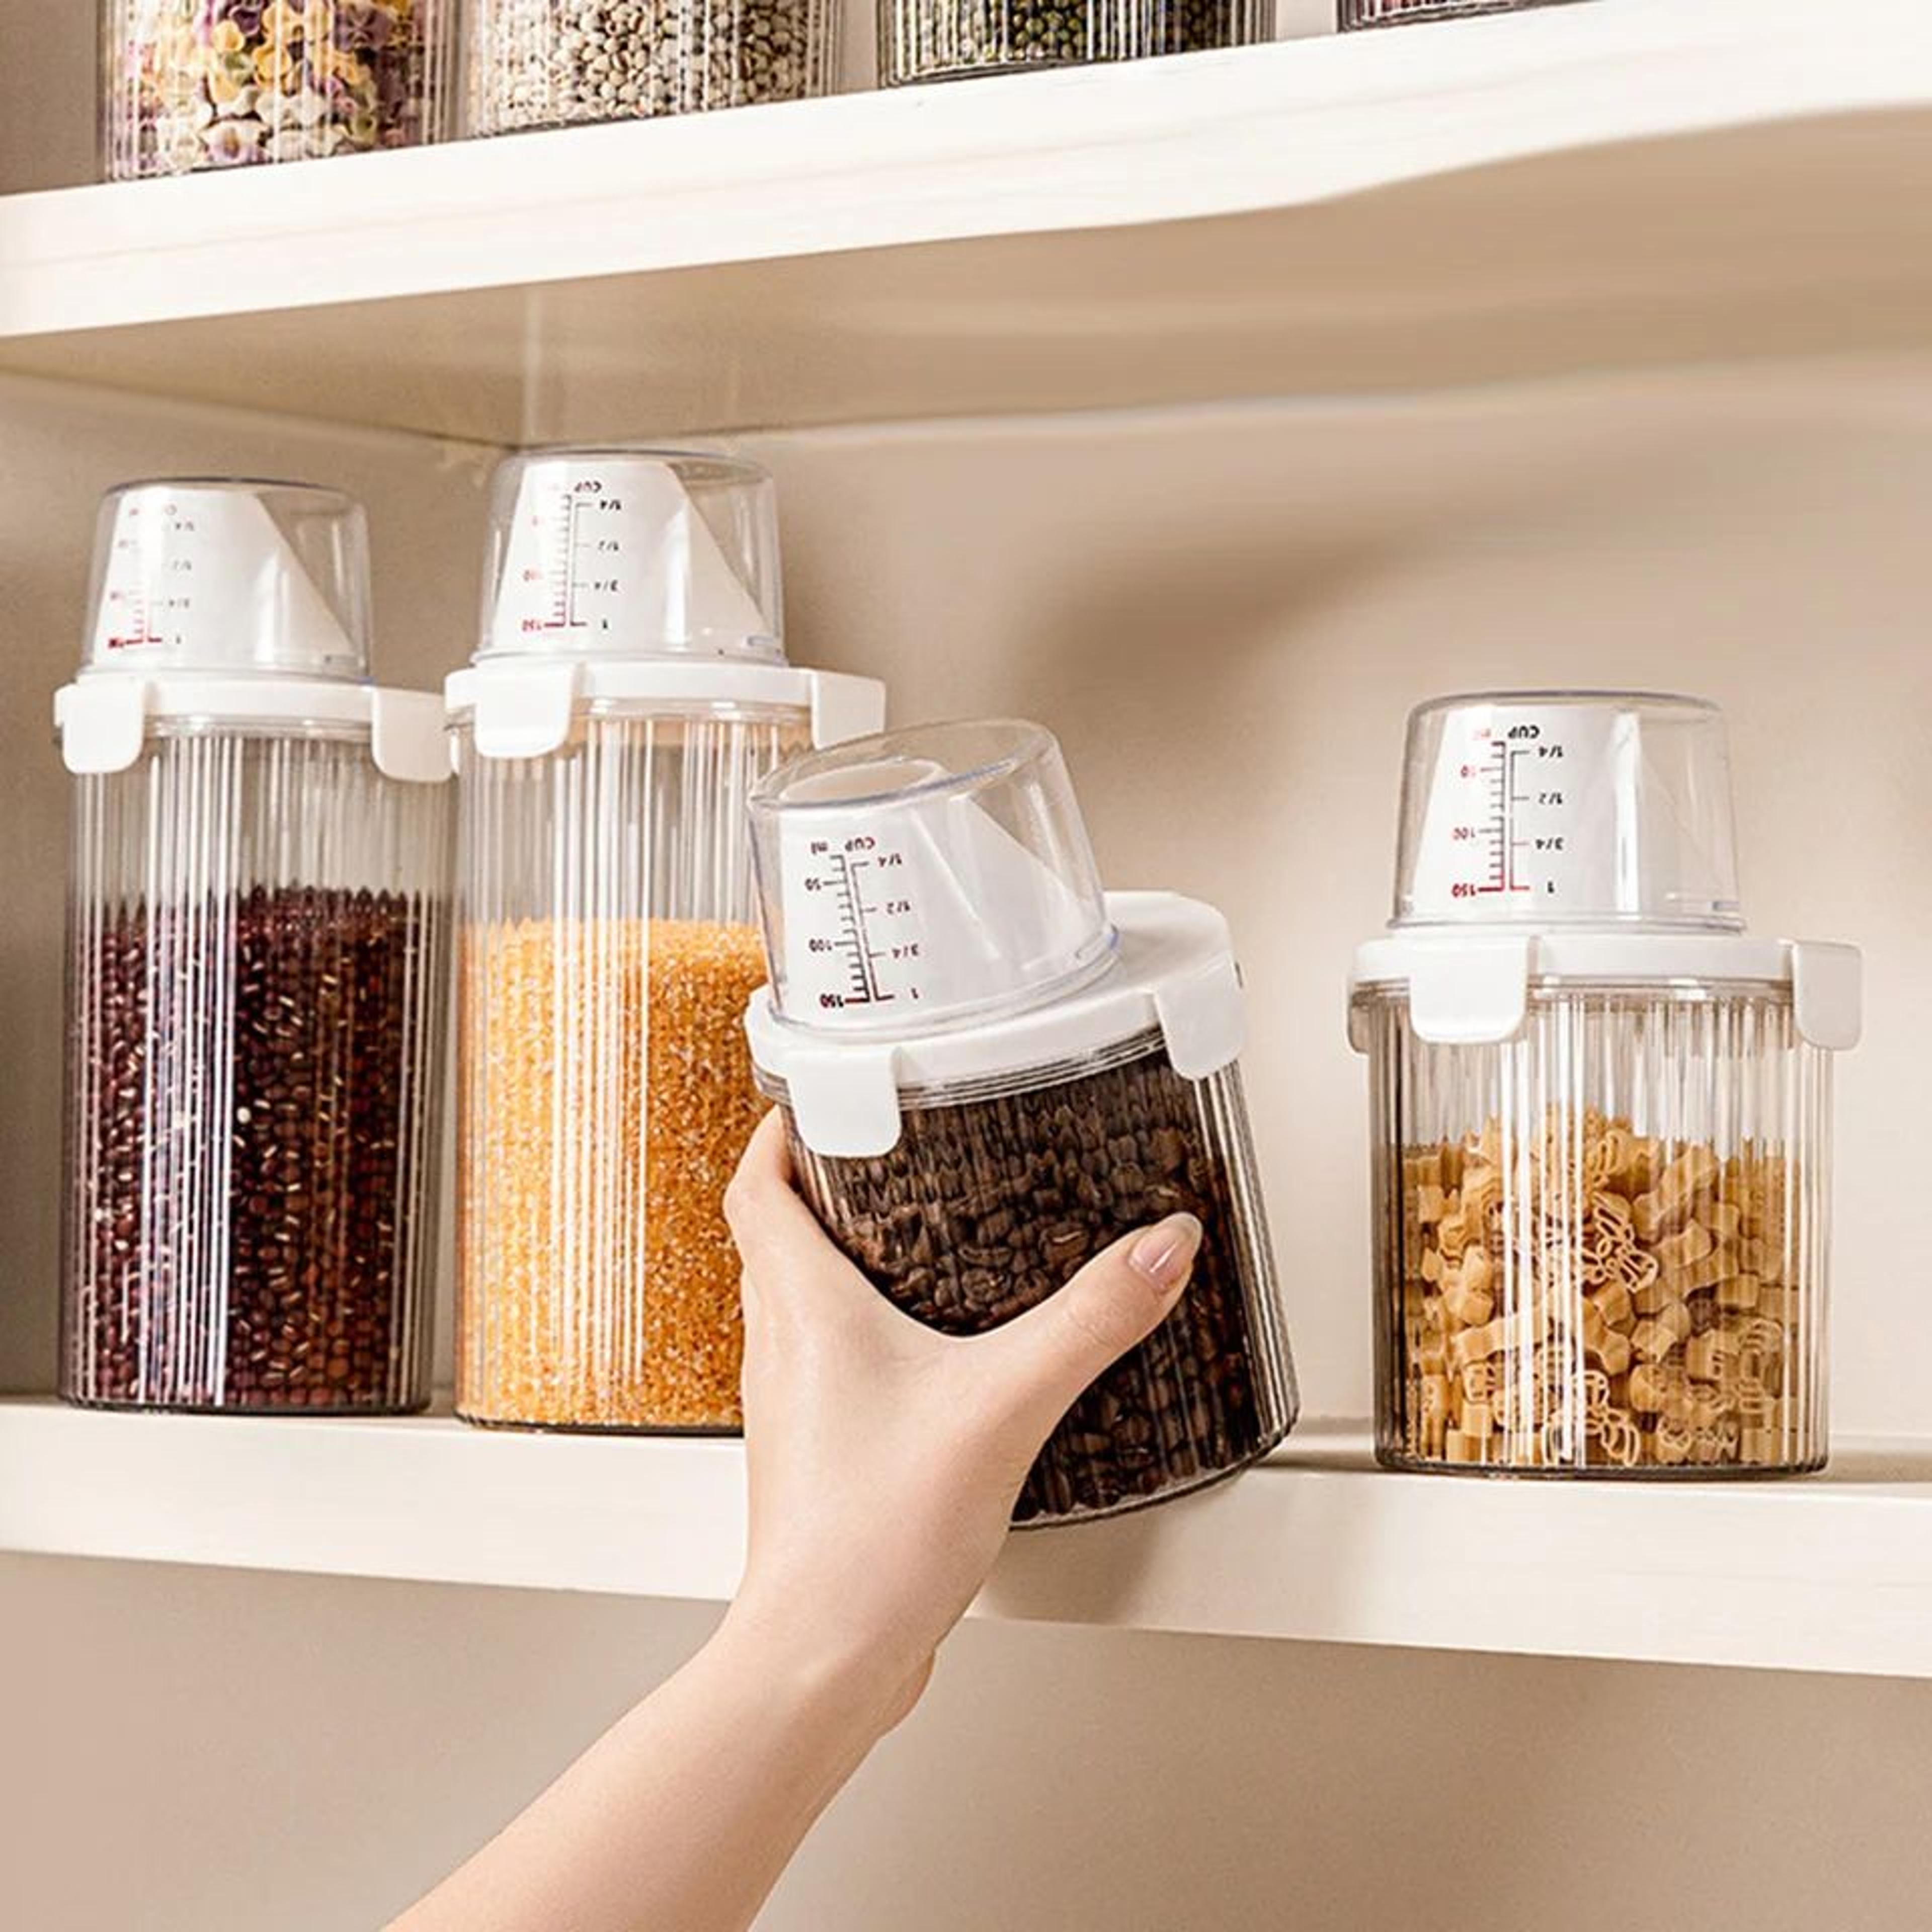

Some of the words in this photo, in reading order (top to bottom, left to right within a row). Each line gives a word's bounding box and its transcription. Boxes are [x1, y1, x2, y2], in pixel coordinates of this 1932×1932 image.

[1507, 725, 1540, 740] CUP
[1539, 746, 1563, 757] 1/4
[1538, 793, 1563, 804] 1/2
[845, 837, 876, 852] CUP
[1536, 837, 1563, 850] 3/4
[878, 853, 903, 868] 1/4
[805, 878, 822, 891] 50
[1452, 884, 1476, 897] 150
[1547, 881, 1555, 893] 1
[887, 901, 910, 914] 1/2
[808, 939, 832, 952] 100
[892, 944, 919, 959] 3/4
[820, 994, 844, 1008] 150
